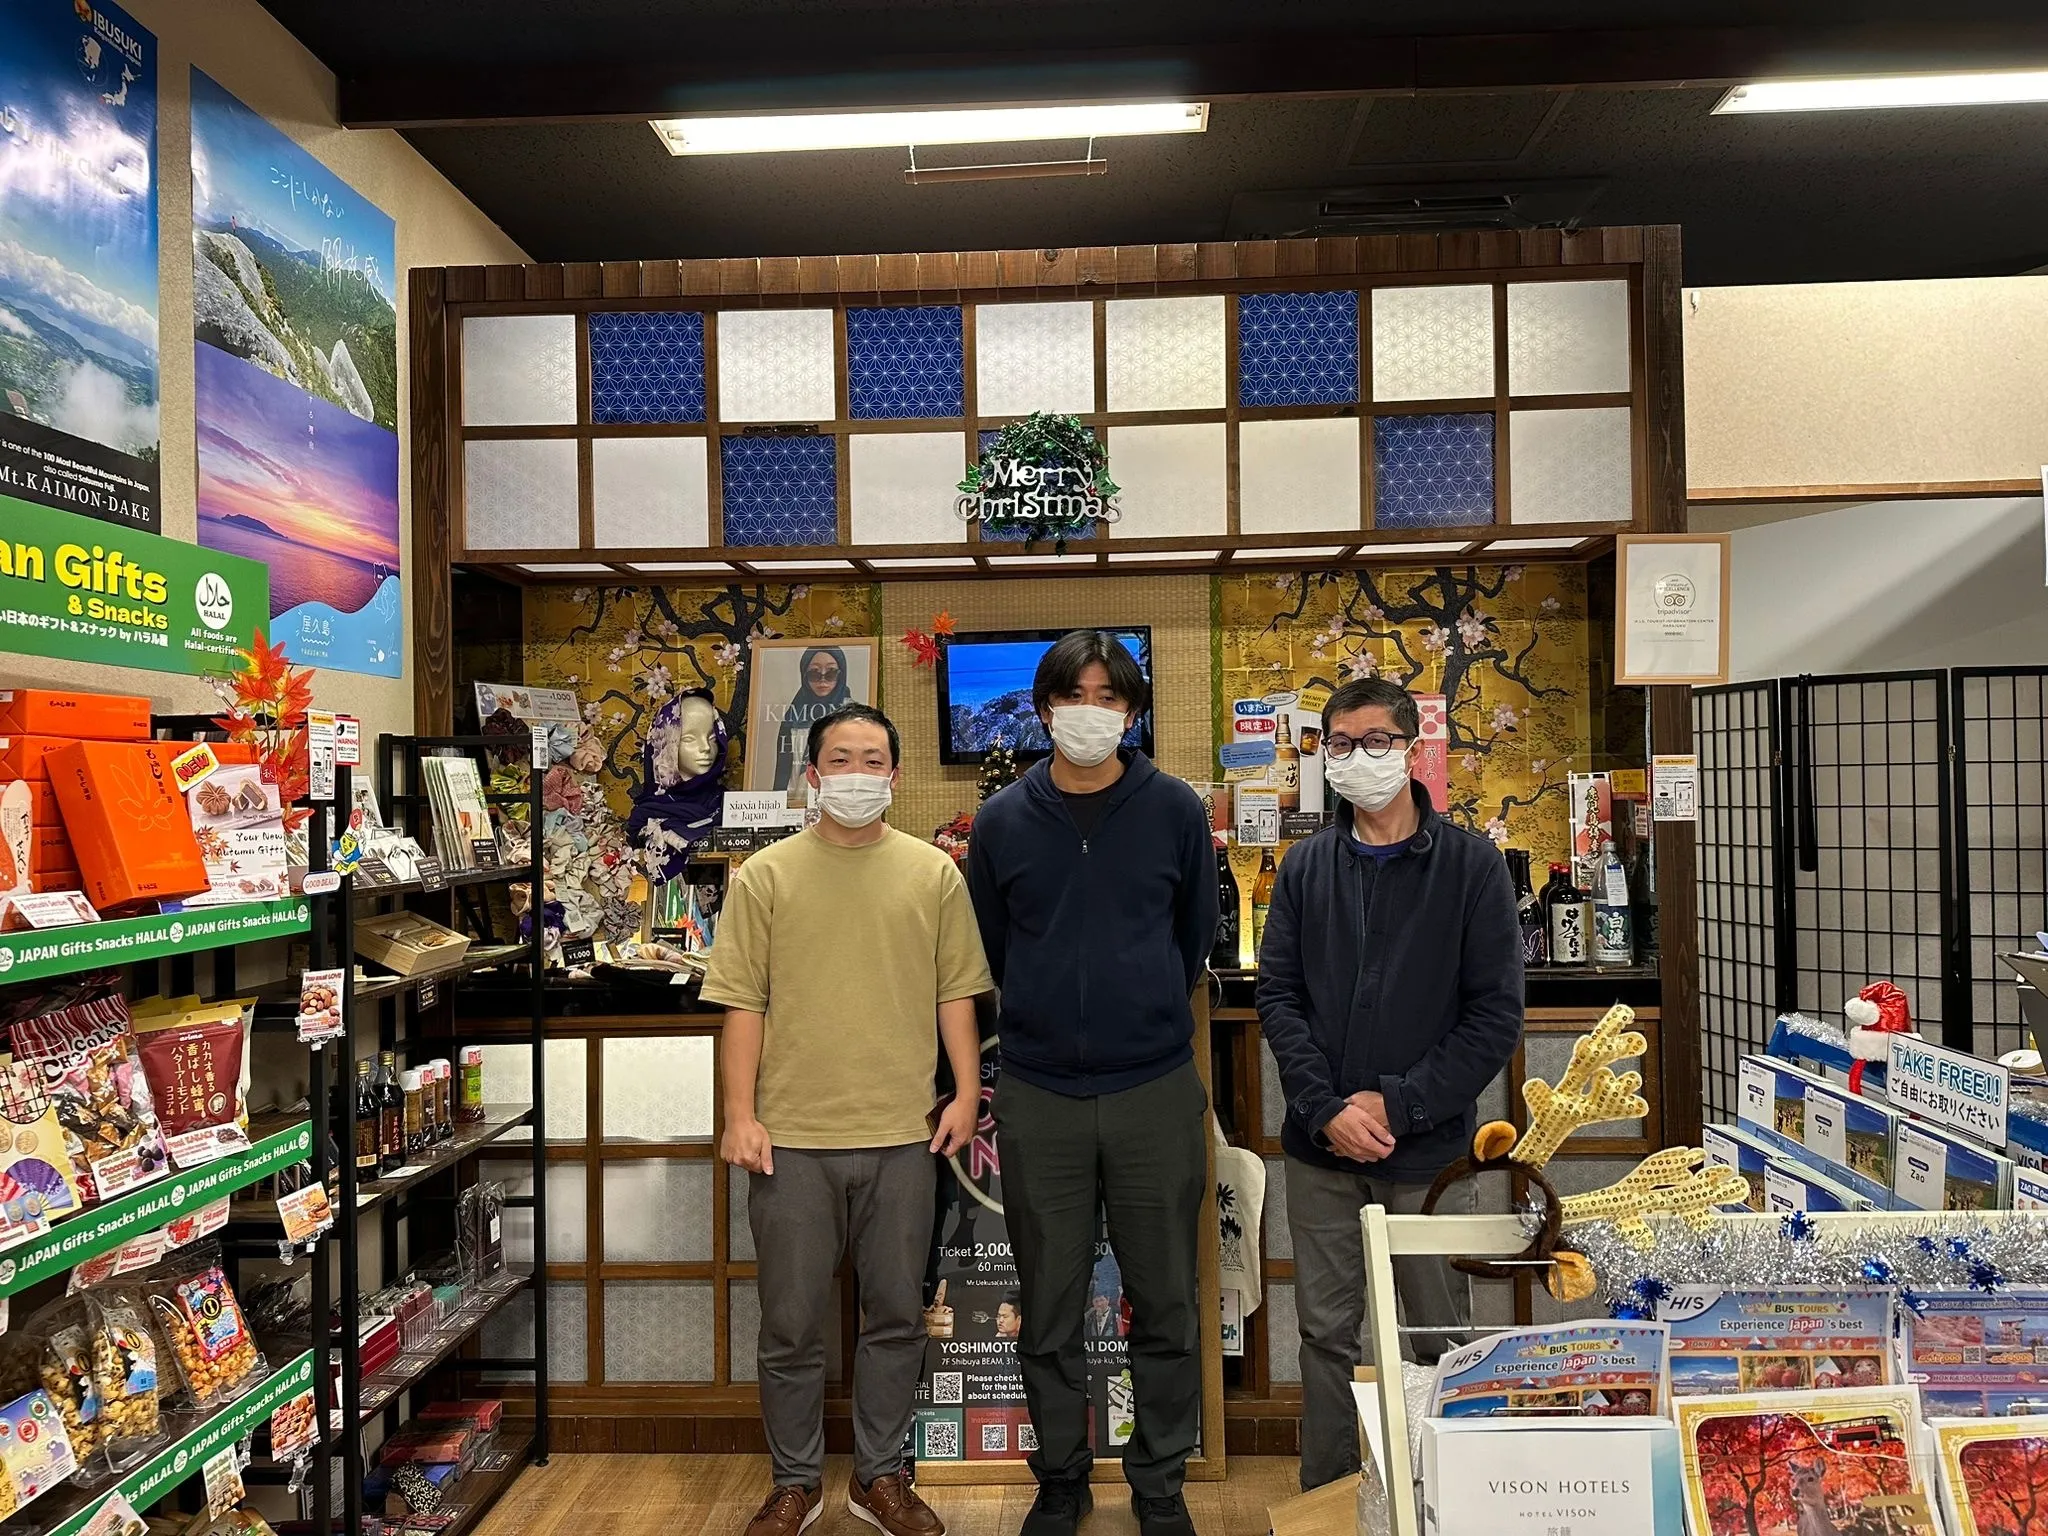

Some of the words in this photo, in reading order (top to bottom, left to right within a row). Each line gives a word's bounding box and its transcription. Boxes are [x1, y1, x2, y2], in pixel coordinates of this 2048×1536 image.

[93, 9, 142, 61] IBUSUKI
[8, 442, 22, 453] one
[23, 446, 30, 454] of
[31, 448, 43, 459] the
[43, 451, 55, 463] 100
[56, 455, 72, 468] Most
[72, 460, 98, 476] Beautiful
[98, 468, 127, 485] Mountains
[43, 464, 57, 475] also
[57, 468, 78, 481] called
[78, 474, 104, 489] Satsuma
[987, 458, 1093, 492] Merry
[953, 491, 1123, 524] Christmas
[55, 543, 168, 604] Gifts
[67, 594, 83, 615] &
[87, 597, 169, 630] Snacks
[203, 610, 226, 620] HALAL
[1658, 608, 1690, 616] tripadvisor
[302, 614, 331, 636] 屋久島
[119, 627, 132, 643] by
[191, 628, 201, 637] All
[203, 628, 224, 642] foods
[225, 634, 237, 644] are
[765, 703, 842, 722] KIMON
[176, 753, 209, 782] NEW
[262, 769, 275, 779] 秋
[729, 800, 756, 810] xiaxia
[758, 799, 781, 811] hijab
[742, 811, 768, 821] Japan
[236, 832, 259, 842] Your
[262, 831, 283, 841] New
[722, 839, 750, 847] ¥6,000
[216, 848, 255, 858] Autumn
[257, 845, 284, 856] Gifts
[185, 921, 216, 937] JAPAN
[217, 919, 240, 931] Gifts
[242, 914, 270, 928] Snacks
[271, 910, 297, 923] HALAL
[1608, 911, 1625, 946] 白波
[16, 945, 58, 963] JAPAN
[61, 942, 93, 956] Gifts
[95, 934, 134, 951] Snacks
[135, 928, 169, 945] HALAL
[202, 1041, 215, 1092] カカオ香る
[1892, 1043, 1935, 1083] TAKE
[1938, 1059, 2002, 1106] FREE!!
[171, 1044, 190, 1115] バターアーモンド
[1891, 1076, 2000, 1130] ご自由にお取りください
[1817, 1125, 1830, 1138] Zao
[186, 1174, 217, 1197] JAPAN
[218, 1164, 242, 1182] Gifts
[243, 1152, 272, 1171] Snacks
[273, 1139, 298, 1158] HALAL
[2016, 1153, 2040, 1170] VISA
[1910, 1169, 1925, 1183] Zao
[2020, 1181, 2032, 1194] ZAO
[18, 1242, 61, 1272] JAPAN
[62, 1229, 95, 1252] Gifts
[96, 1212, 136, 1236] Snacks
[137, 1195, 171, 1219] HALAL
[937, 1246, 971, 1257] Ticket
[978, 1261, 991, 1272] 60
[1669, 1296, 1705, 1310] HIS
[1774, 1304, 1794, 1314] BUS
[1798, 1303, 1829, 1313] TOURS
[1720, 1318, 1784, 1331] Experience
[1788, 1317, 1824, 1332] Japan
[1828, 1319, 1837, 1329] 's
[1839, 1319, 1863, 1329] best
[941, 1357, 950, 1365] 7F
[951, 1357, 980, 1367] Shibuya
[981, 1357, 1004, 1367] BEAM,
[1451, 1350, 1482, 1369] HIS
[1549, 1344, 1568, 1355] BUS
[1571, 1342, 1601, 1352] TOURS
[1494, 1361, 1558, 1375] Experience
[1560, 1354, 1597, 1371] Japan
[1600, 1354, 1610, 1366] 's
[1611, 1354, 1637, 1366] best
[966, 1374, 993, 1383] Please
[993, 1374, 1017, 1383] check
[981, 1383, 993, 1391] for
[994, 1383, 1007, 1391] the
[967, 1391, 991, 1400] about
[188, 1428, 220, 1460] JAPAN
[220, 1414, 245, 1436] Gifts
[245, 1392, 274, 1418] Snacks
[274, 1372, 300, 1398] HALAL
[971, 1416, 1007, 1424] Instagram
[139, 1464, 173, 1495] HALAL
[1488, 1480, 1548, 1494] VISON
[1559, 1480, 1630, 1494] HOTELS
[1556, 1508, 1596, 1518] VISON
